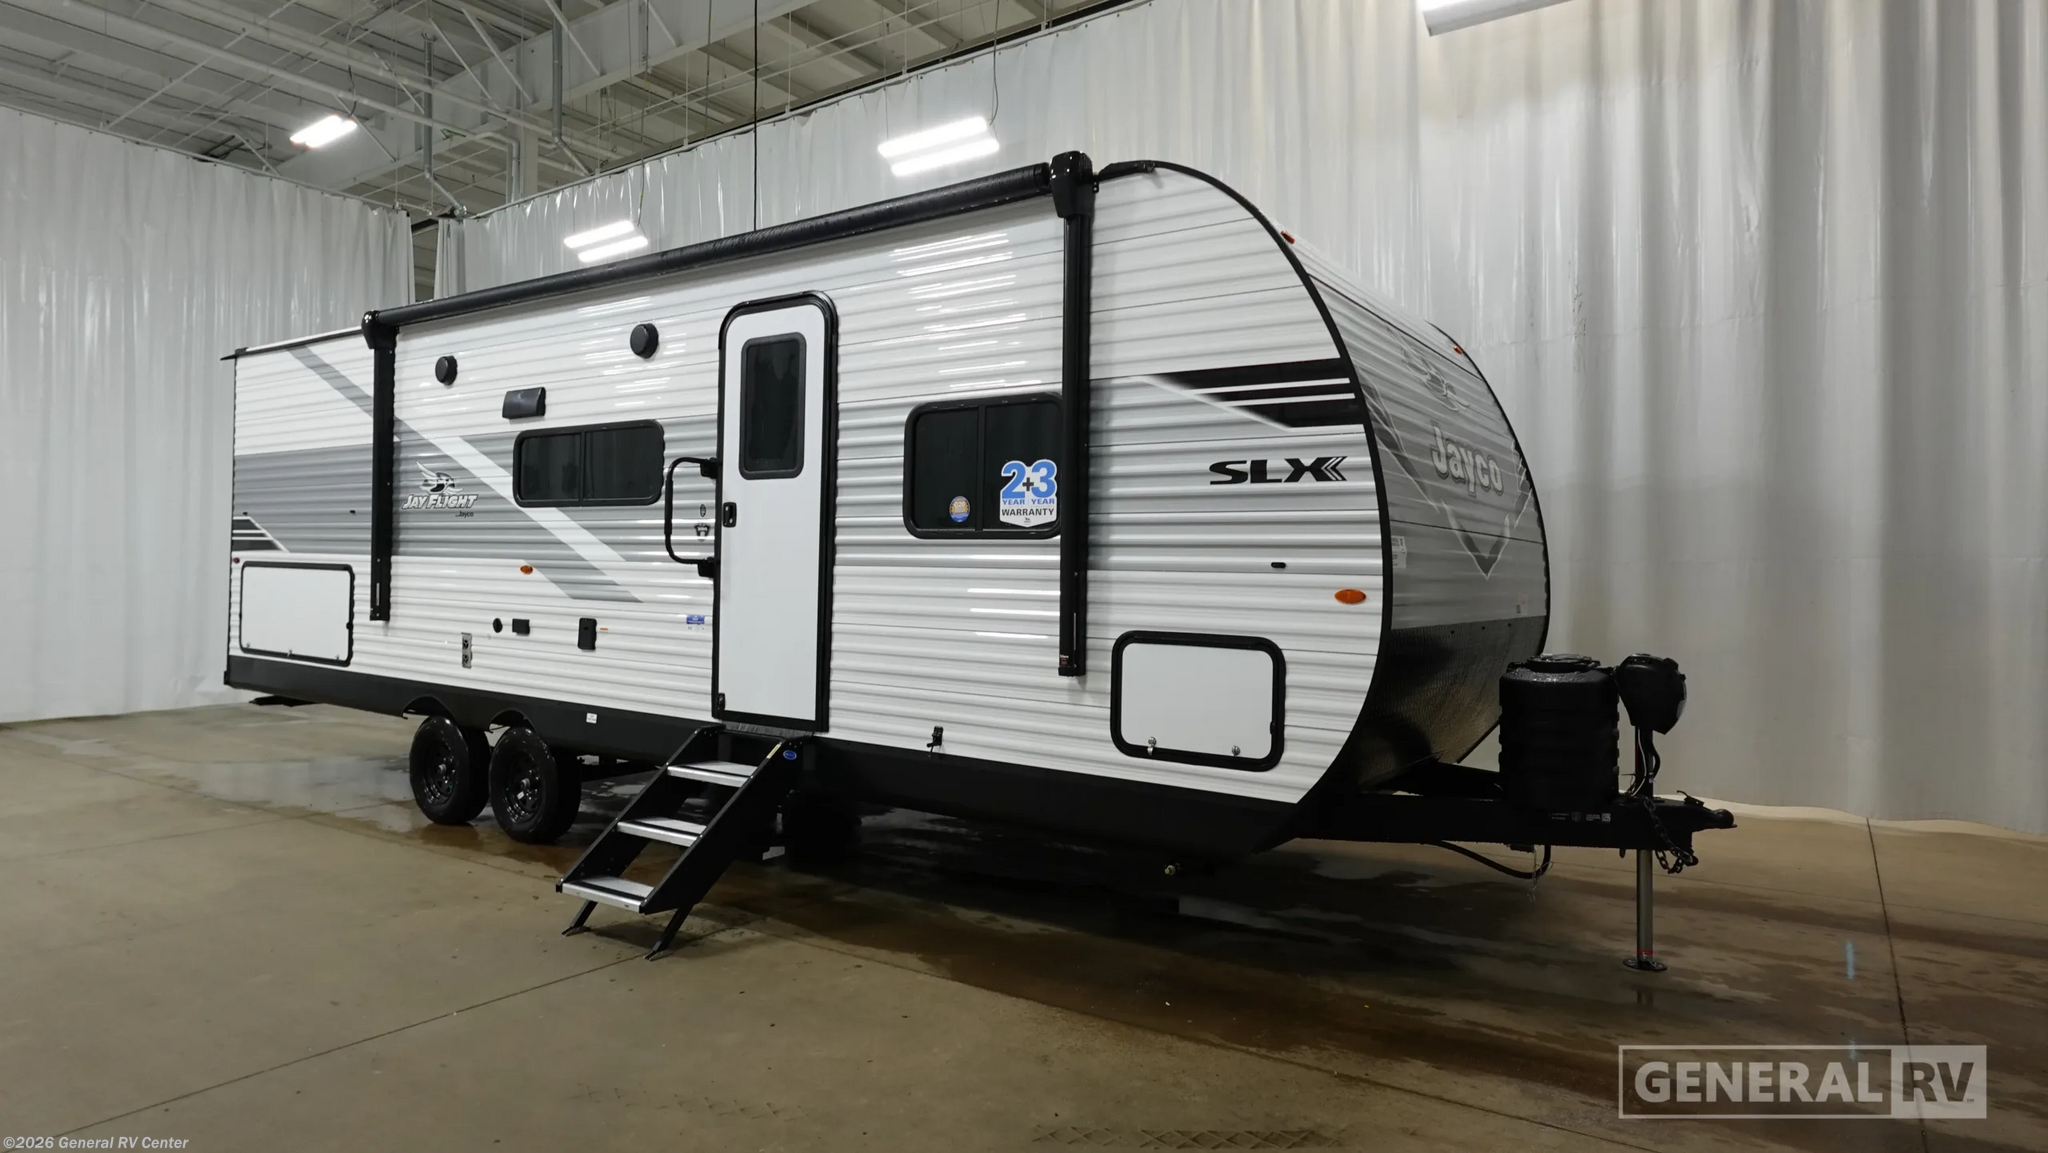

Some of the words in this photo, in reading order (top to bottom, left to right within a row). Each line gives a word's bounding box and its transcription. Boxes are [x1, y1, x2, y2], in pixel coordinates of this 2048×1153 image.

[1209, 456, 1347, 485] SLX
[1431, 423, 1503, 496] Jayco
[402, 495, 427, 509] JAY
[426, 494, 478, 509] FLIGHT
[1001, 508, 1055, 516] WARRANTY
